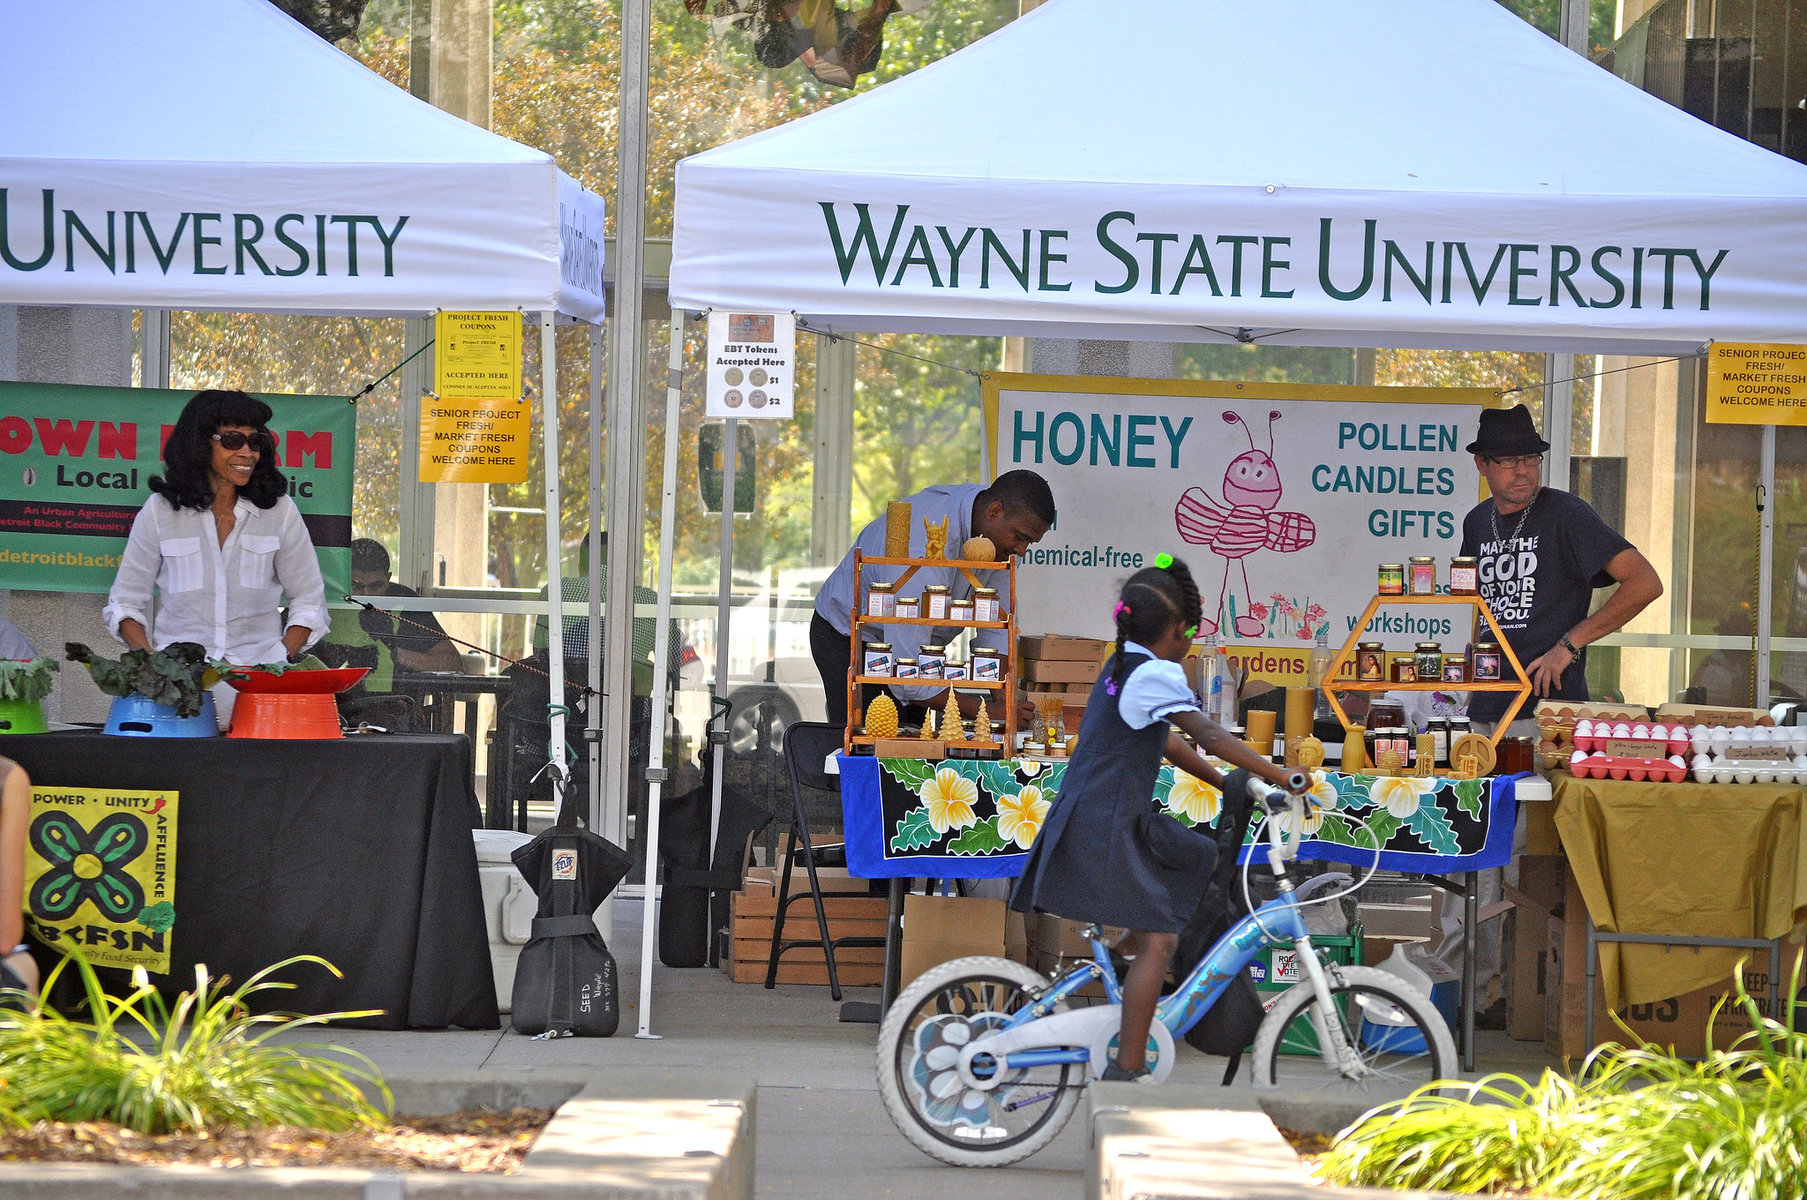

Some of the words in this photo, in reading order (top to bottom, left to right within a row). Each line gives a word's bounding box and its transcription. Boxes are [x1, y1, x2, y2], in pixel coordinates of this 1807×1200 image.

[0, 189, 410, 278] UNIVERSITY
[817, 201, 1073, 293] WAYNE
[1094, 211, 1296, 298] STATE
[1318, 217, 1731, 310] UNIVERSITY
[724, 345, 743, 353] EBT
[745, 345, 778, 354] Tokens
[1719, 349, 1760, 359] SENIOR
[1763, 350, 1807, 360] PROJEC
[716, 357, 760, 366] Accepted
[762, 358, 785, 366] Here
[1746, 362, 1785, 371] FRESH/
[769, 376, 779, 384] $1
[1723, 373, 1768, 382] MARKET
[1771, 374, 1806, 383] FRESH
[1737, 385, 1791, 394] COUPONS
[769, 397, 780, 405] $2
[1720, 396, 1775, 406] WELCOME
[1777, 398, 1807, 407] HERE
[430, 409, 470, 418] SENIOR
[472, 410, 521, 419] PROJECT
[456, 421, 494, 430] FRESH/
[434, 432, 479, 441] MARKET
[480, 433, 515, 442] FRESH
[1012, 410, 1194, 469] HONEY
[1339, 422, 1458, 452] POLLEN
[448, 444, 501, 453] COUPONS
[431, 455, 486, 465] WELCOME
[487, 457, 516, 465] HERE
[57, 464, 138, 489] Local
[1311, 463, 1455, 496] CANDLES
[24, 506, 39, 514] An
[42, 507, 75, 517] Urban
[77, 508, 136, 519] Agricultura
[0, 518, 31, 528] etroit
[34, 519, 62, 529] Black
[65, 520, 126, 532] Community
[1368, 509, 1455, 539] GIFTS
[1480, 541, 1506, 556] MAY
[1509, 535, 1539, 552] THE
[1022, 545, 1143, 568] hemical-free
[1479, 552, 1538, 583] GOD
[1480, 583, 1496, 598] OF
[1346, 611, 1452, 640] workshops
[33, 794, 86, 805] POWER
[105, 796, 150, 808] UNITY
[153, 814, 168, 898] AFFLUENCE
[101, 951, 122, 961] Food
[125, 955, 162, 966] Security
[580, 984, 590, 1013] SEED
